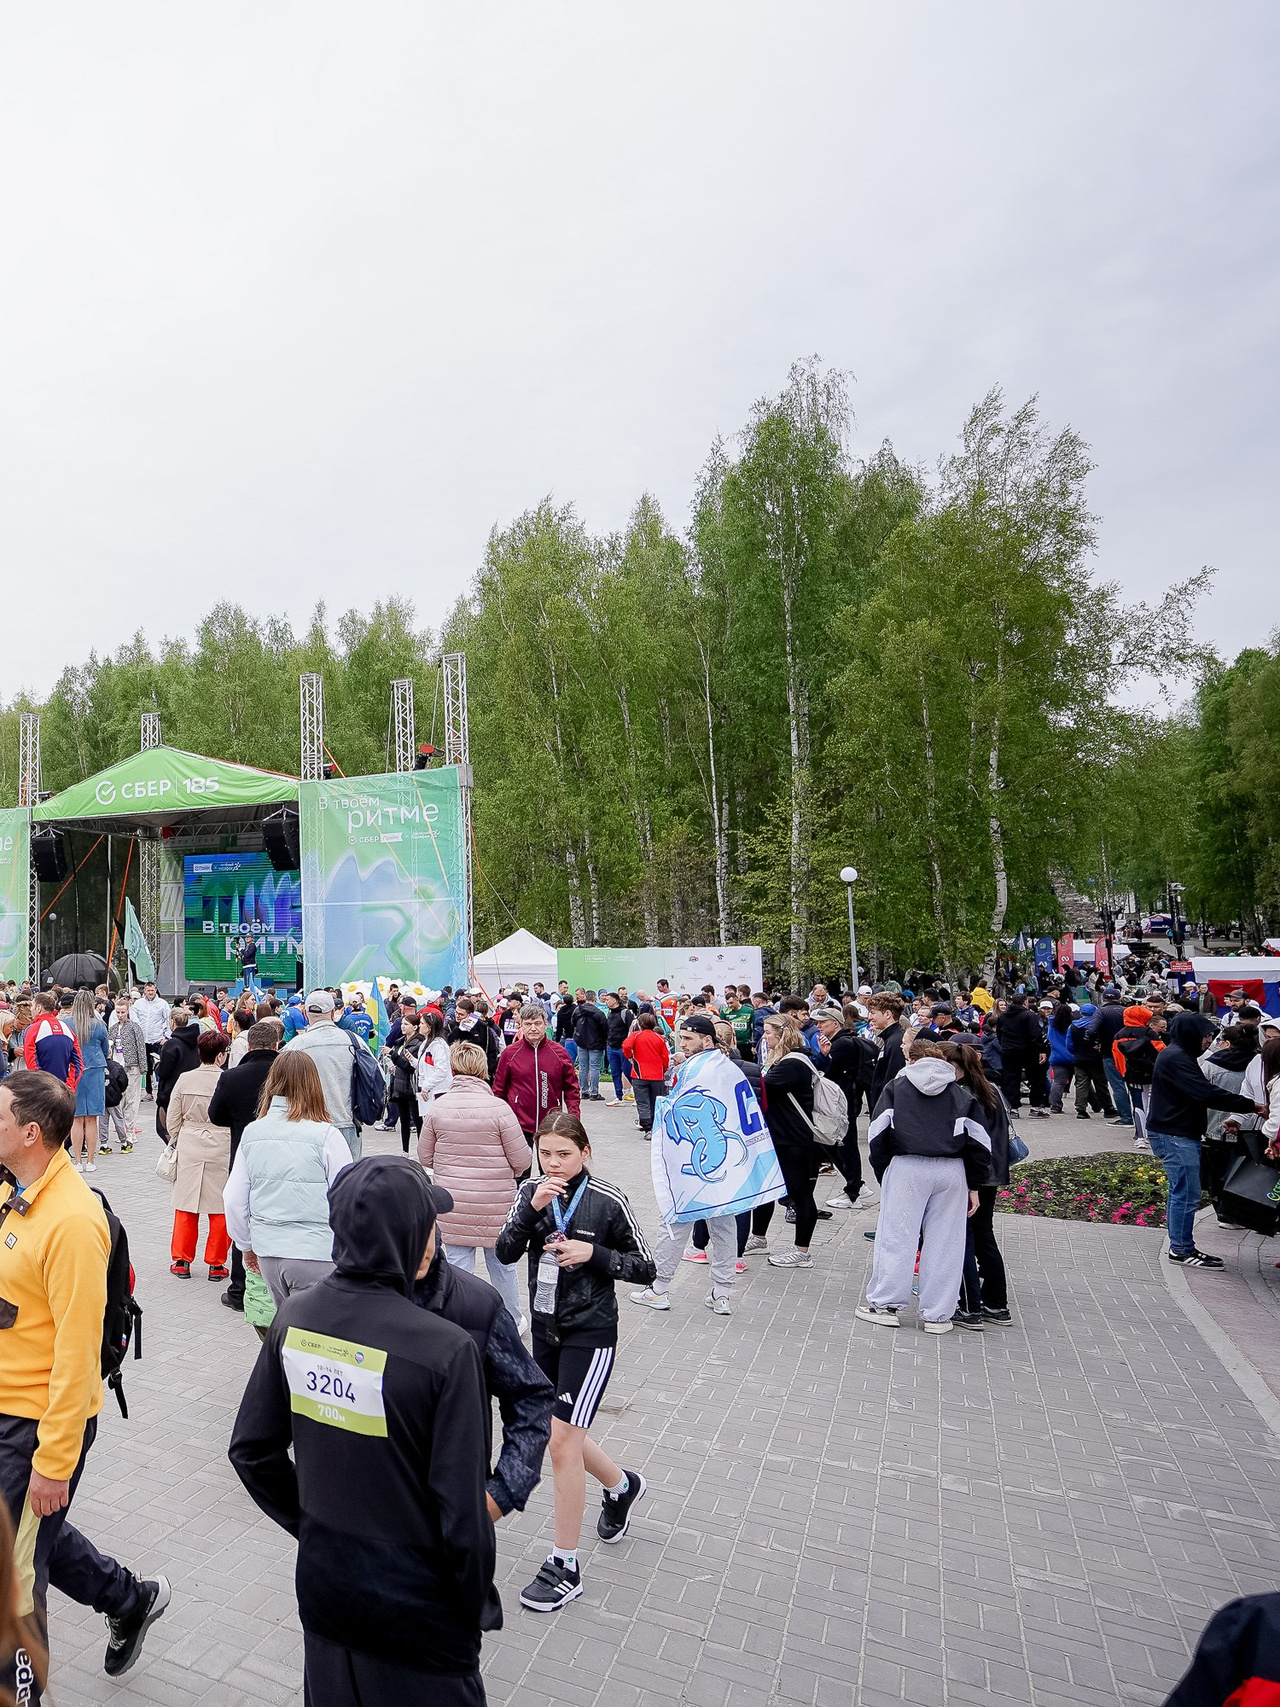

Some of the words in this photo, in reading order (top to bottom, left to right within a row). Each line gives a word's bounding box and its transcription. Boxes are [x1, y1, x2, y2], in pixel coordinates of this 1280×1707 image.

[121, 780, 172, 799] СБЕР
[182, 776, 220, 794] 185
[318, 797, 328, 810] В
[334, 794, 380, 810] твоём
[347, 803, 439, 834] ритме
[202, 920, 215, 934] В
[219, 918, 275, 934] твоём
[225, 936, 303, 960] ритм
[734, 1080, 768, 1136] С
[306, 1371, 356, 1404] 3204
